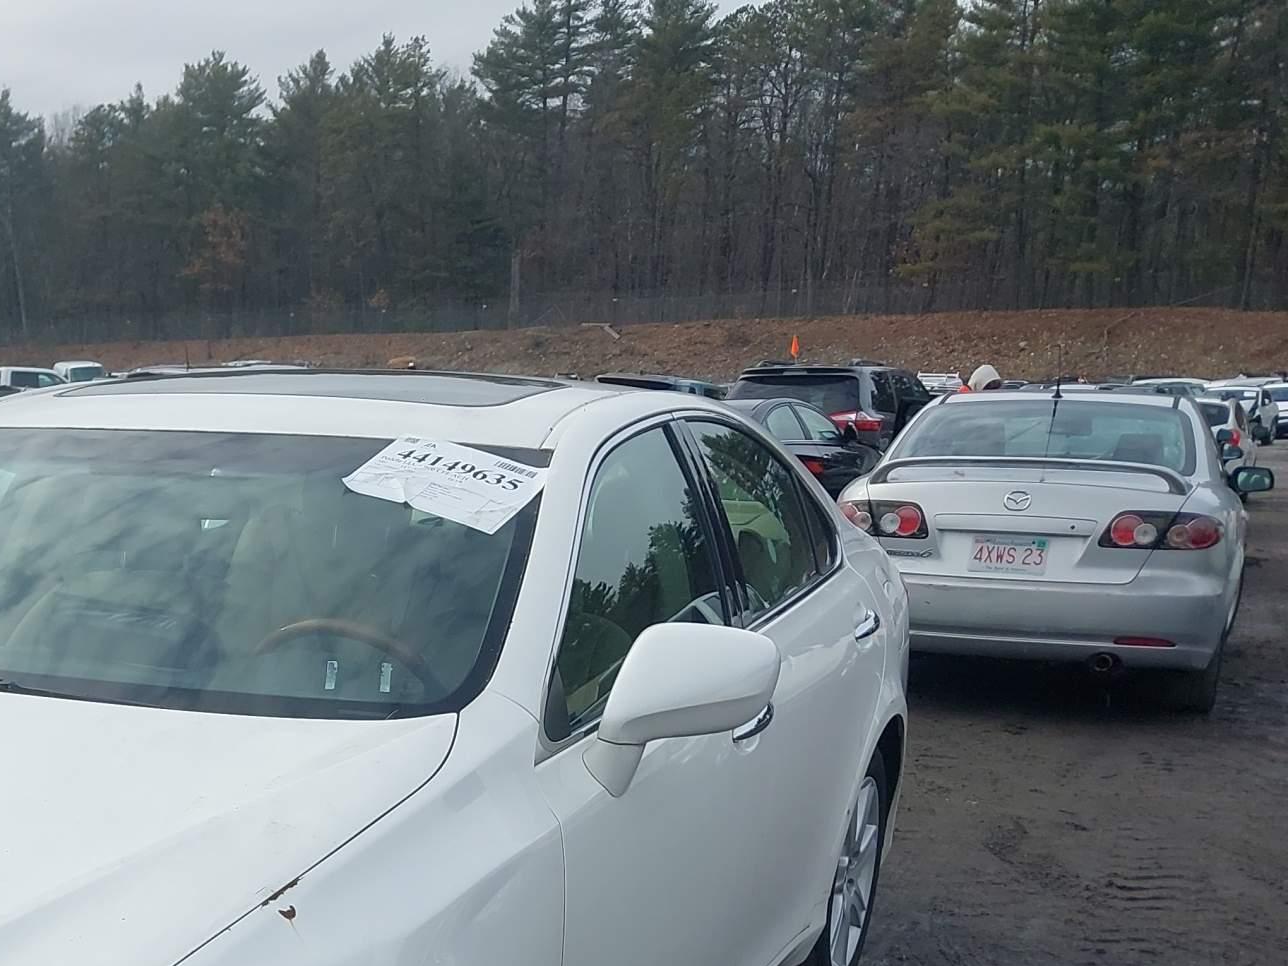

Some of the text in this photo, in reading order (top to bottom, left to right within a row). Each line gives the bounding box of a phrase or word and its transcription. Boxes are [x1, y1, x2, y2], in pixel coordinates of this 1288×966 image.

[396, 448, 526, 492] 44149635
[972, 545, 1045, 566] 4XWS 23
